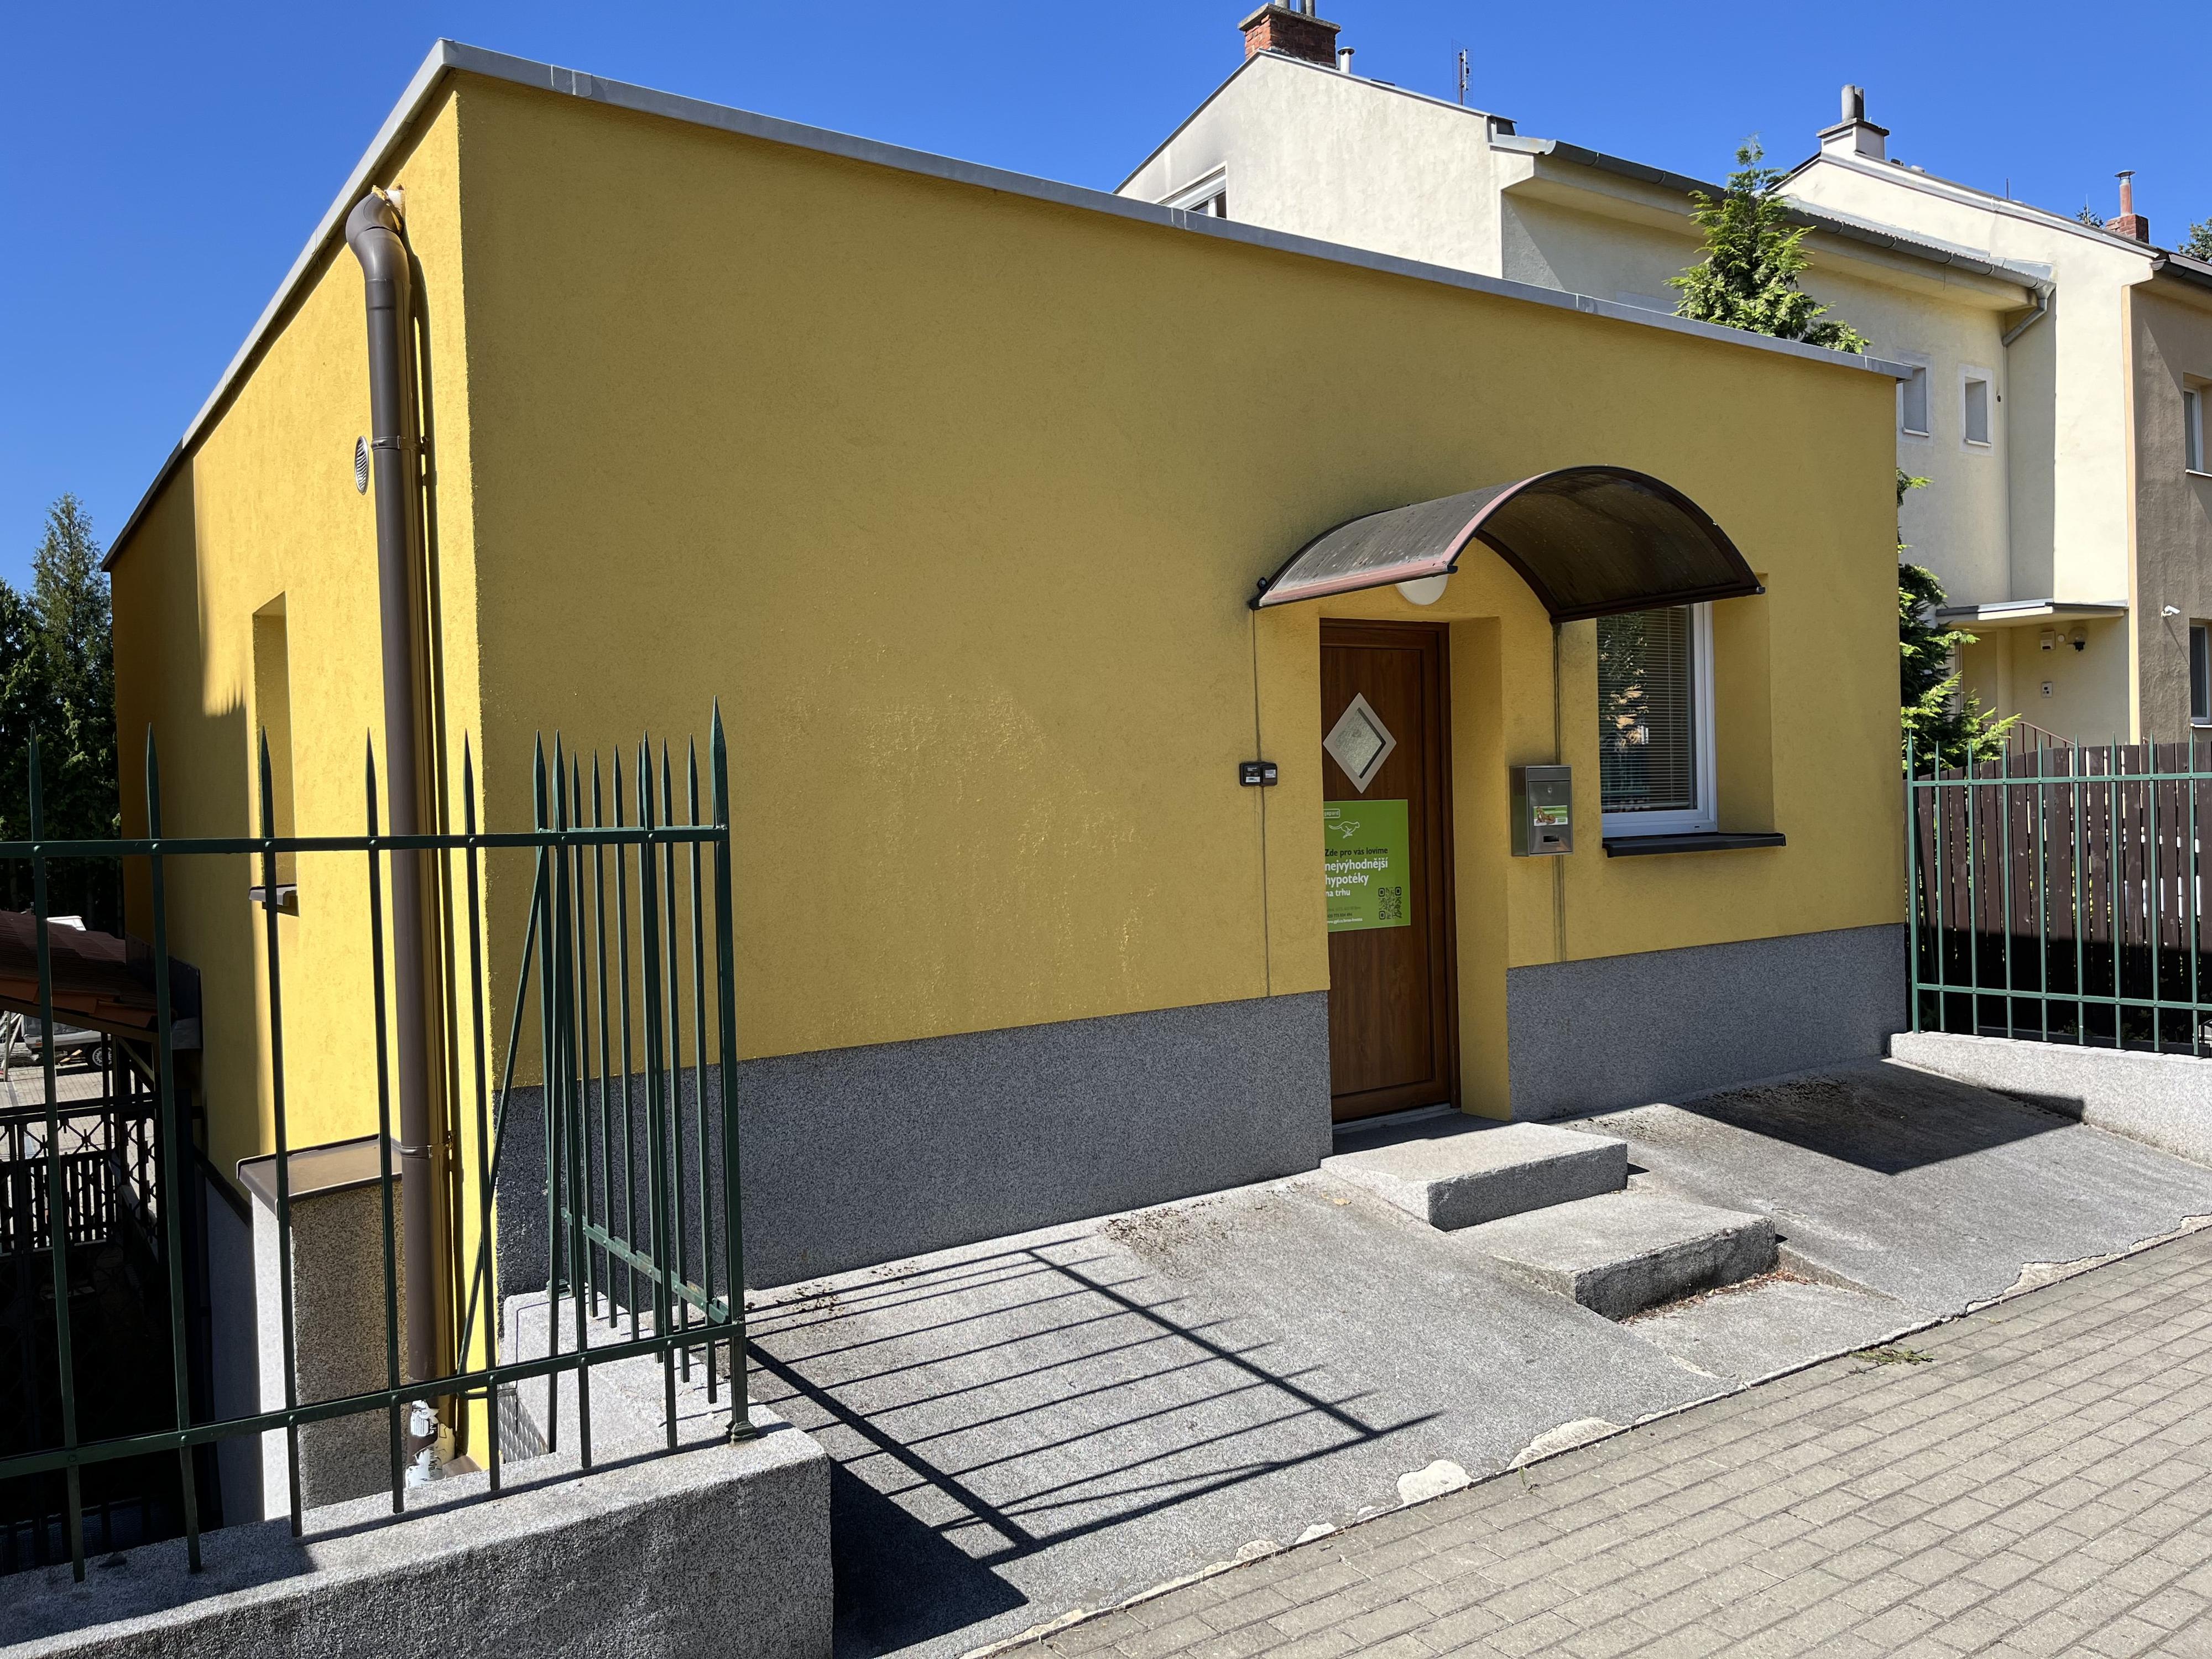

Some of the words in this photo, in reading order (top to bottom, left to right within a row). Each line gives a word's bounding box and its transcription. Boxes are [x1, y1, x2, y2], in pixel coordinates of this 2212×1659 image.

[1340, 849, 1352, 858] pro
[1325, 857, 1388, 873] nejvýhodnější
[1325, 873, 1369, 888] hypotéky
[1335, 888, 1350, 896] trhu
